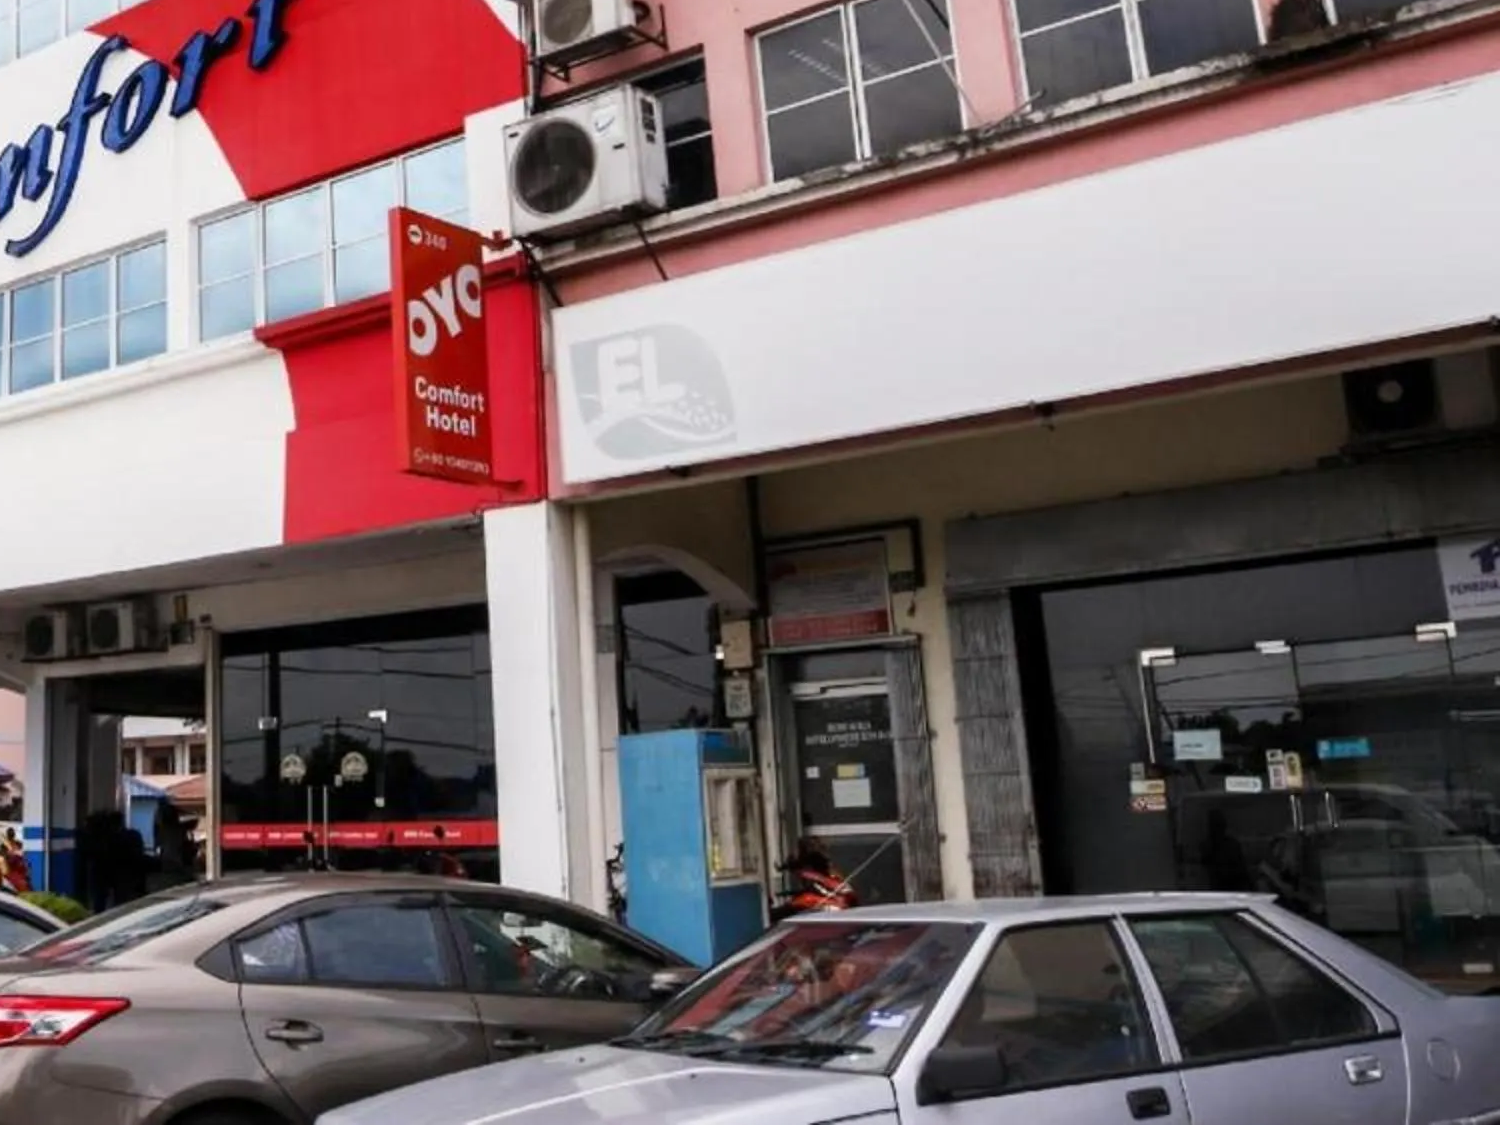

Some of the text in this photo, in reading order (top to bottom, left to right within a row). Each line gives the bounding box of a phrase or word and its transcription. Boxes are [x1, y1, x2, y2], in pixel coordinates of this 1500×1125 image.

[408, 264, 482, 357] OYO
[414, 376, 485, 412] Comfort
[425, 408, 476, 438] Hotel
